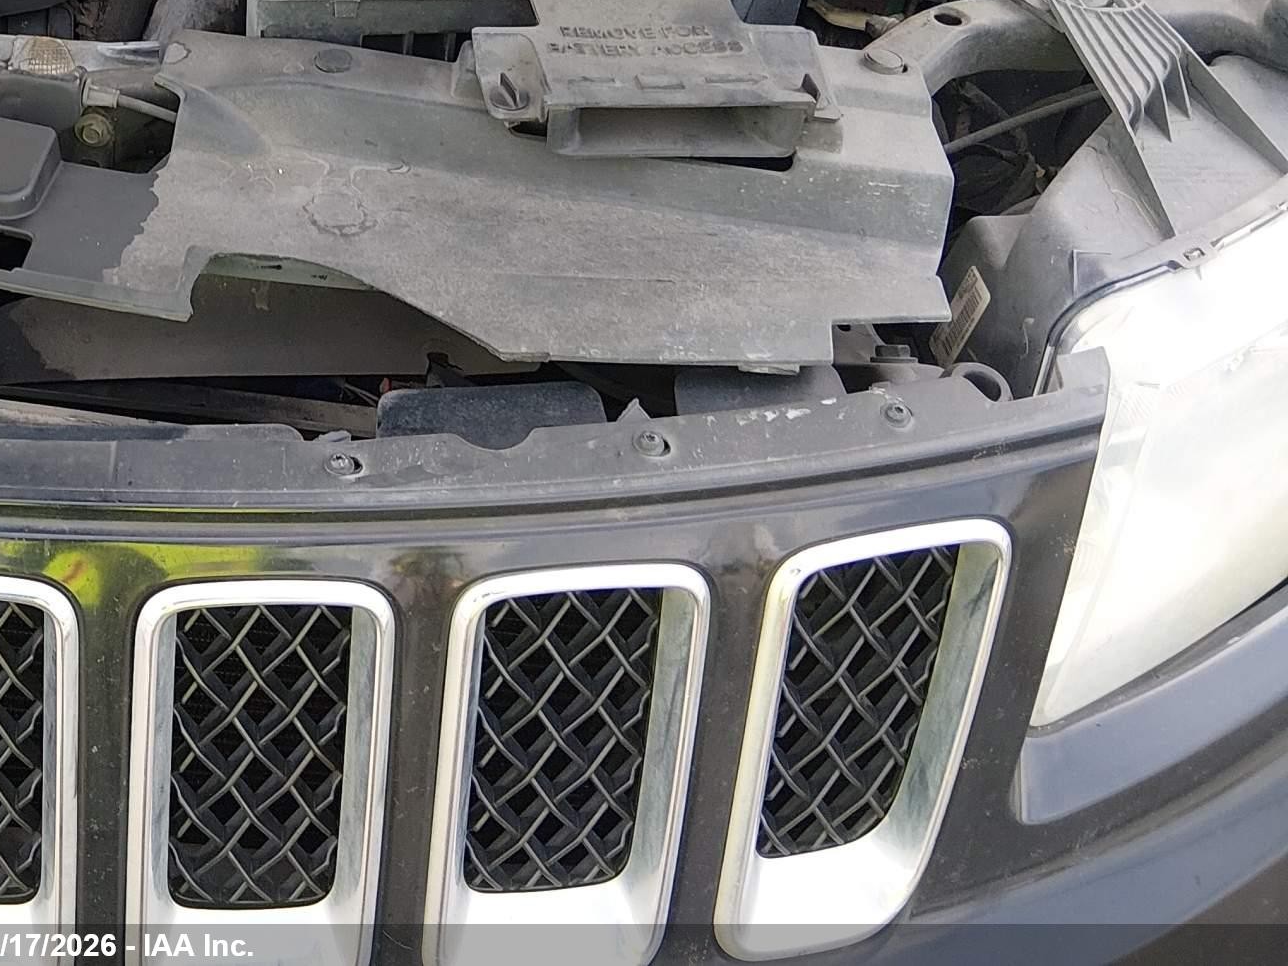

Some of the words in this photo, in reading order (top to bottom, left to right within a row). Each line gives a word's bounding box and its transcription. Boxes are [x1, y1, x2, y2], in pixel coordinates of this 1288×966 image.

[559, 25, 657, 40] REMOVE
[661, 24, 710, 39] FOR
[650, 40, 745, 56] ACCESS
